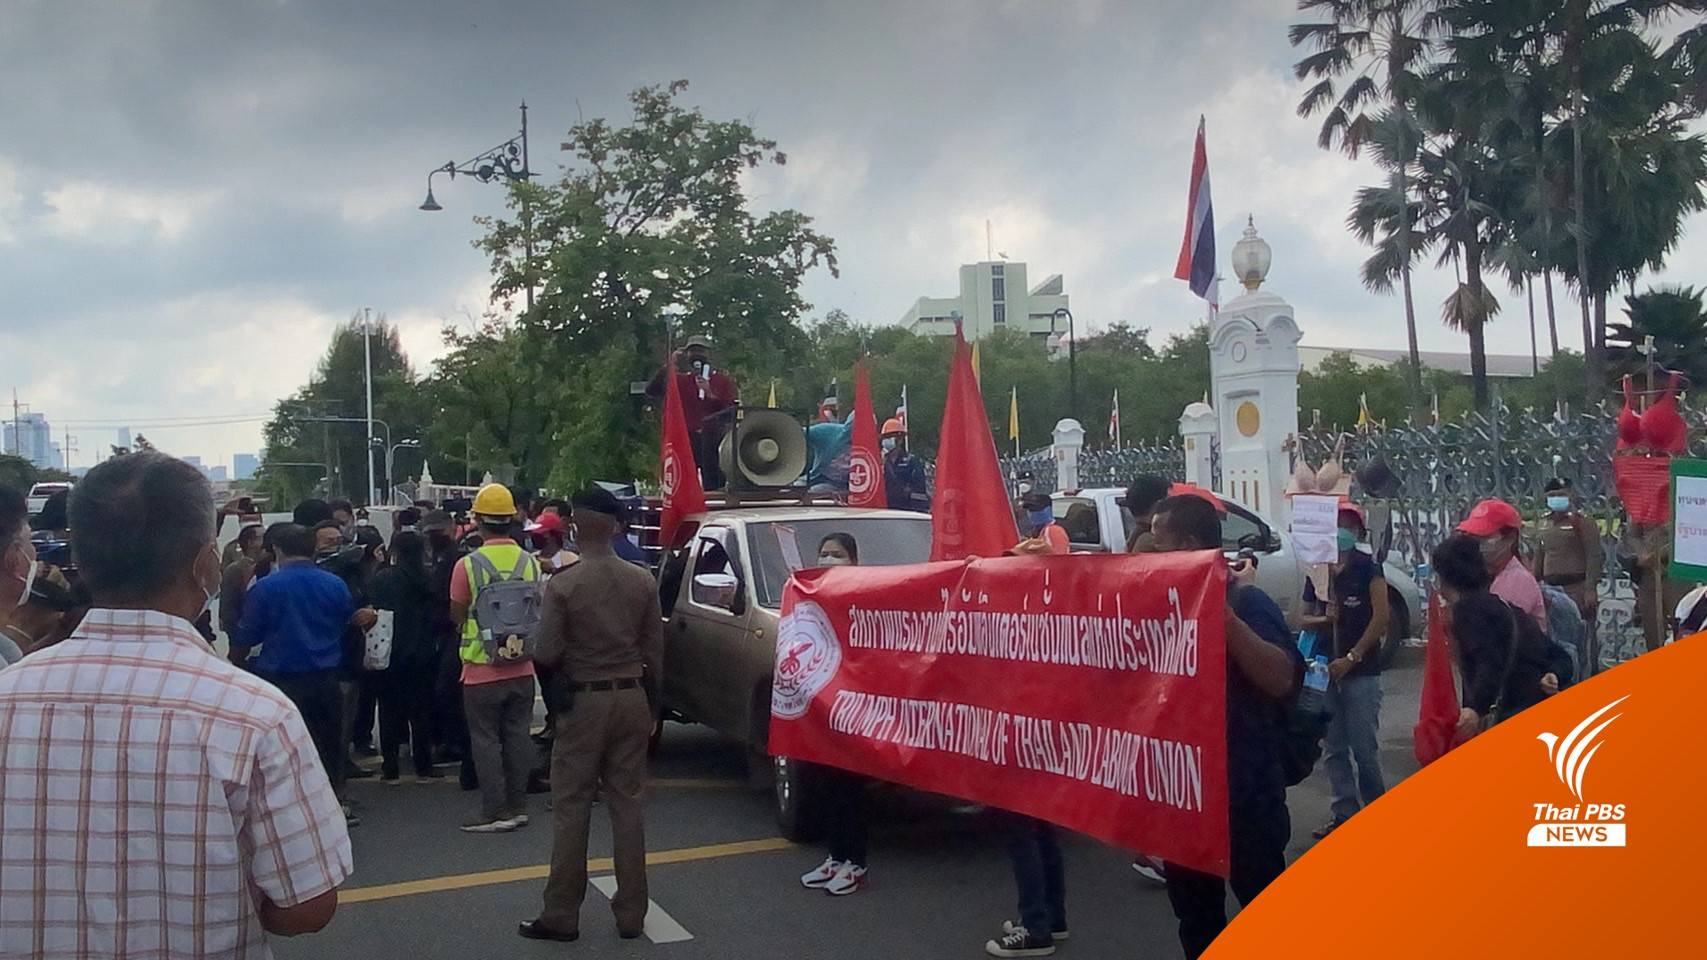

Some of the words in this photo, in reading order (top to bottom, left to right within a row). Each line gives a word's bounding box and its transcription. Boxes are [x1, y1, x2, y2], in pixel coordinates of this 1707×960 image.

[829, 689, 897, 740] TRIUMPH
[892, 697, 993, 762] INTERNATIONAL
[991, 711, 1010, 765] OF
[1013, 715, 1092, 781] THAILAND
[1142, 736, 1201, 813] UNION
